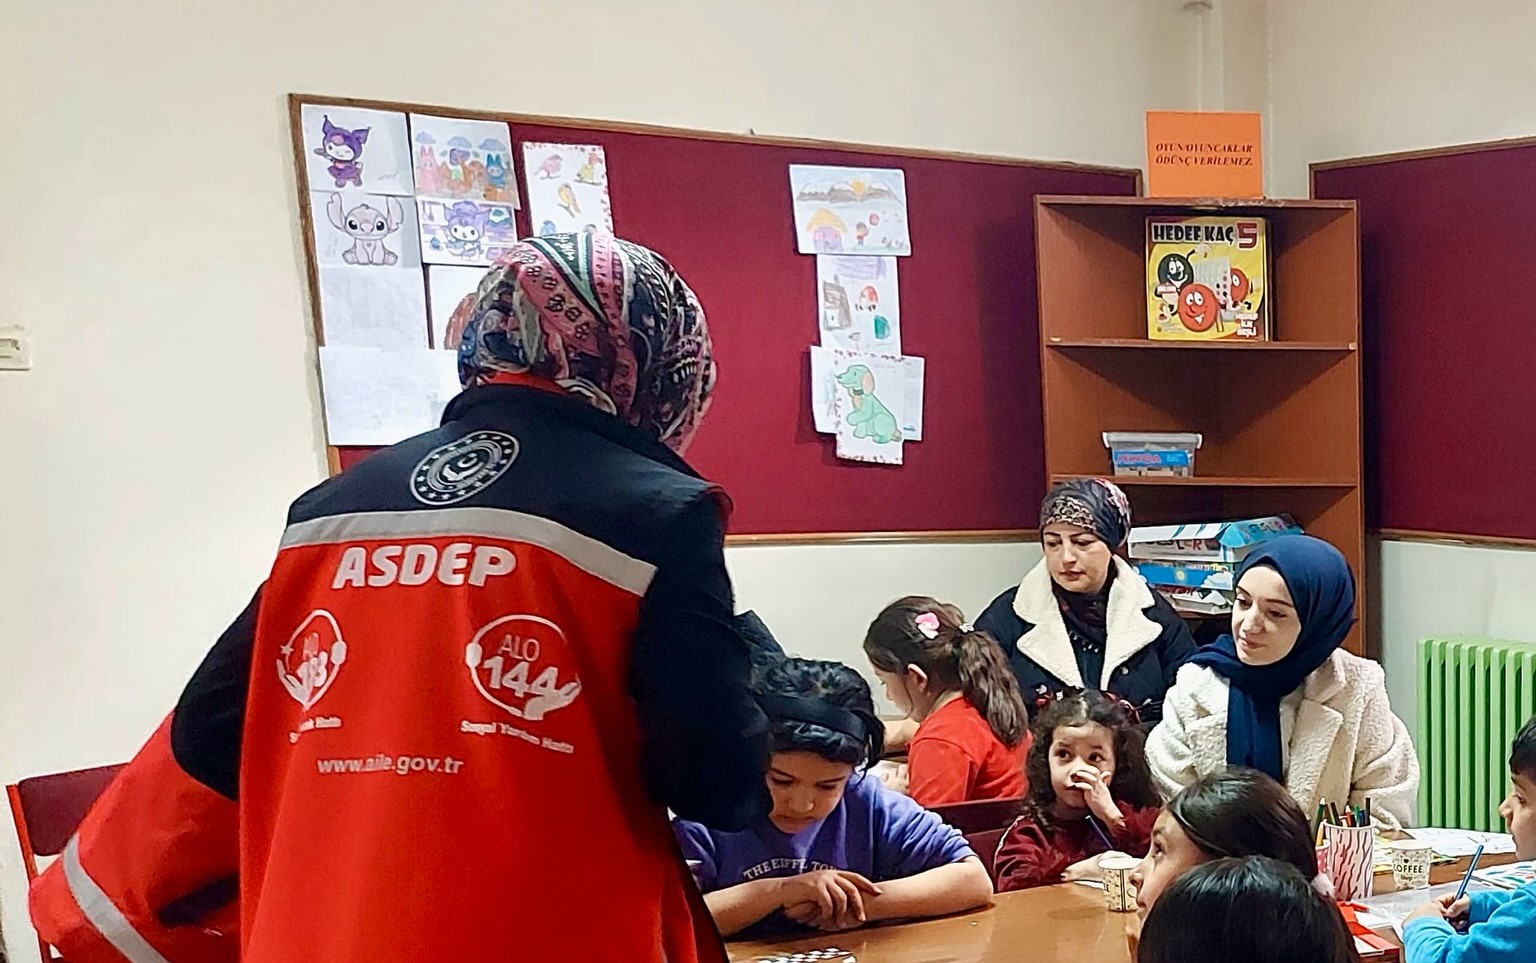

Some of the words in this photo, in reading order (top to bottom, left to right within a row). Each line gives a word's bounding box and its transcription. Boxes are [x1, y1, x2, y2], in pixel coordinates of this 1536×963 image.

[1153, 224, 1201, 241] HEDEF
[1204, 226, 1234, 245] KAÇ
[1236, 222, 1258, 249] 5
[331, 542, 517, 590] ASDEP
[498, 634, 541, 662] ALO
[481, 655, 561, 698] 144
[316, 753, 465, 776] www.aile.gov.tr
[743, 861, 772, 880] THE
